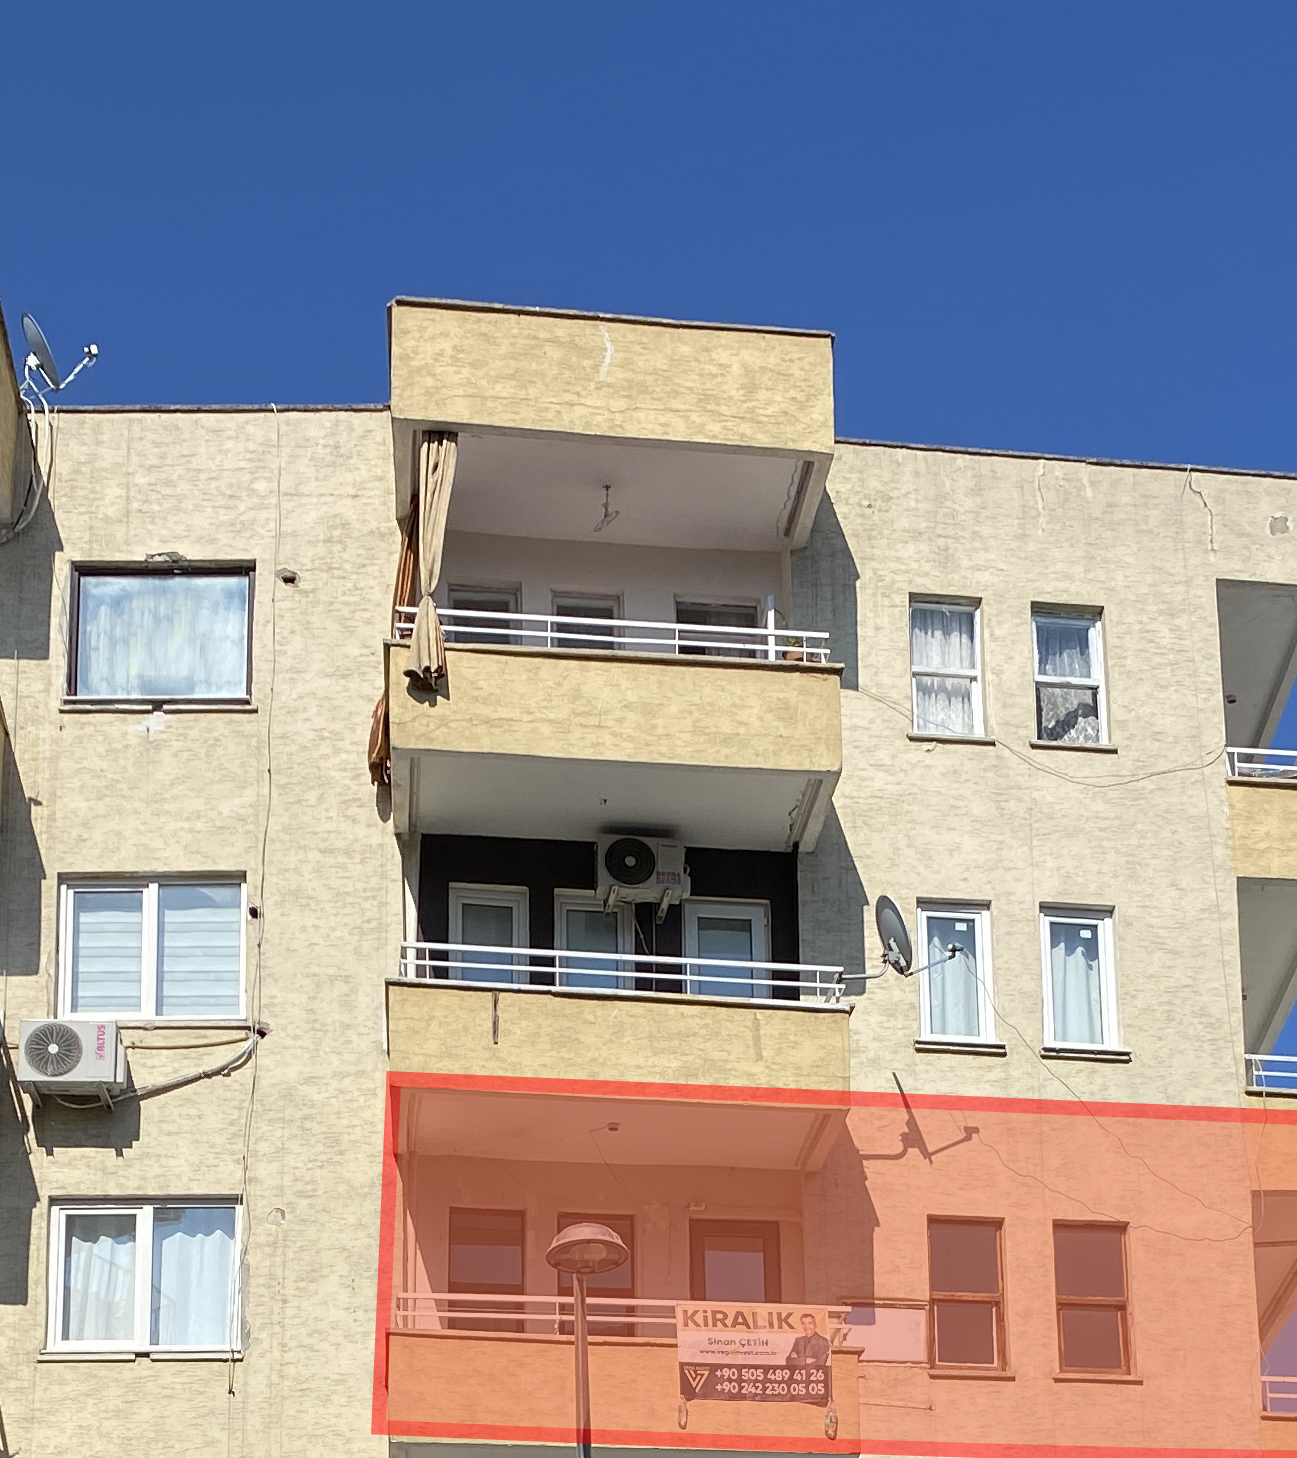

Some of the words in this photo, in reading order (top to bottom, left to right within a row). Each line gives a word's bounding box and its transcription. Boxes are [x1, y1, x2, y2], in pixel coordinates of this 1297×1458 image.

[96, 1024, 106, 1052] ALTUS
[707, 1337, 736, 1346] Sinan
[715, 1368, 738, 1380] +90
[741, 1368, 764, 1380] 505
[767, 1369, 790, 1380] 489
[793, 1369, 806, 1380] 41
[809, 1369, 824, 1381] 26
[715, 1382, 738, 1394] +90
[741, 1383, 763, 1394] 242
[765, 1383, 787, 1394] 230
[790, 1384, 806, 1395] 05
[809, 1383, 825, 1395] 05
